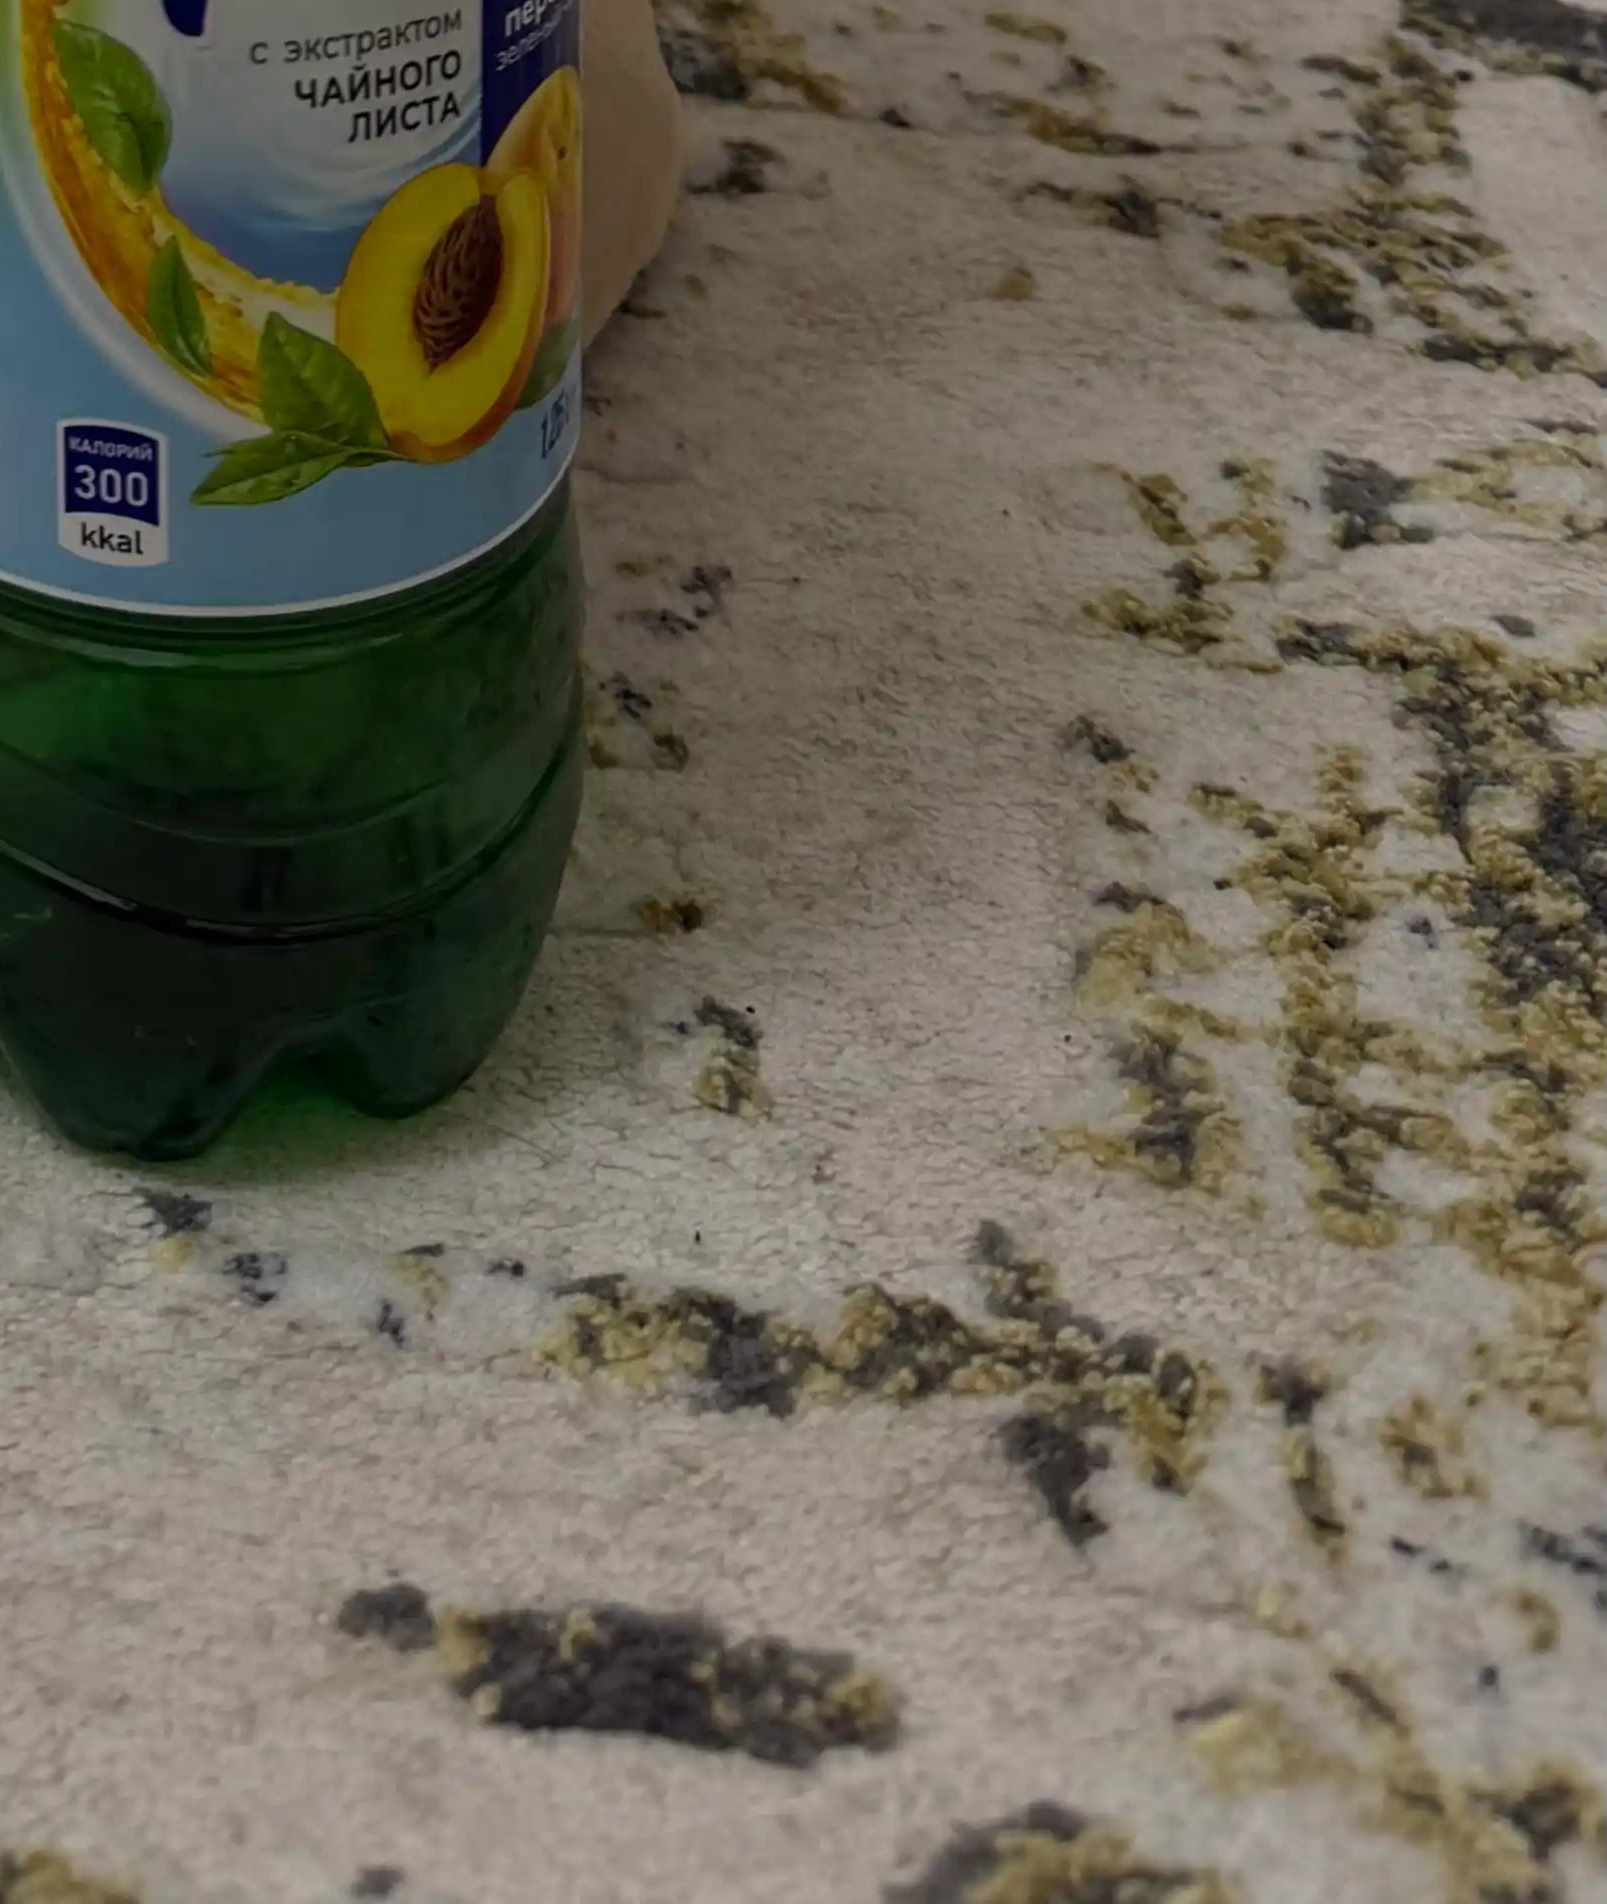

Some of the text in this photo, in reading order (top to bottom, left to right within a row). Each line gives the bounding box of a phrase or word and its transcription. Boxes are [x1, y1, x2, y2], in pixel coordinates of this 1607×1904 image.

[283, 8, 463, 62] экстрактом
[294, 49, 462, 109] ЧАЙНОГО
[348, 91, 462, 144] ЛИСТА
[68, 435, 154, 461] КАЛОРИЙ
[73, 464, 149, 507] 300
[80, 521, 145, 555] kkal
